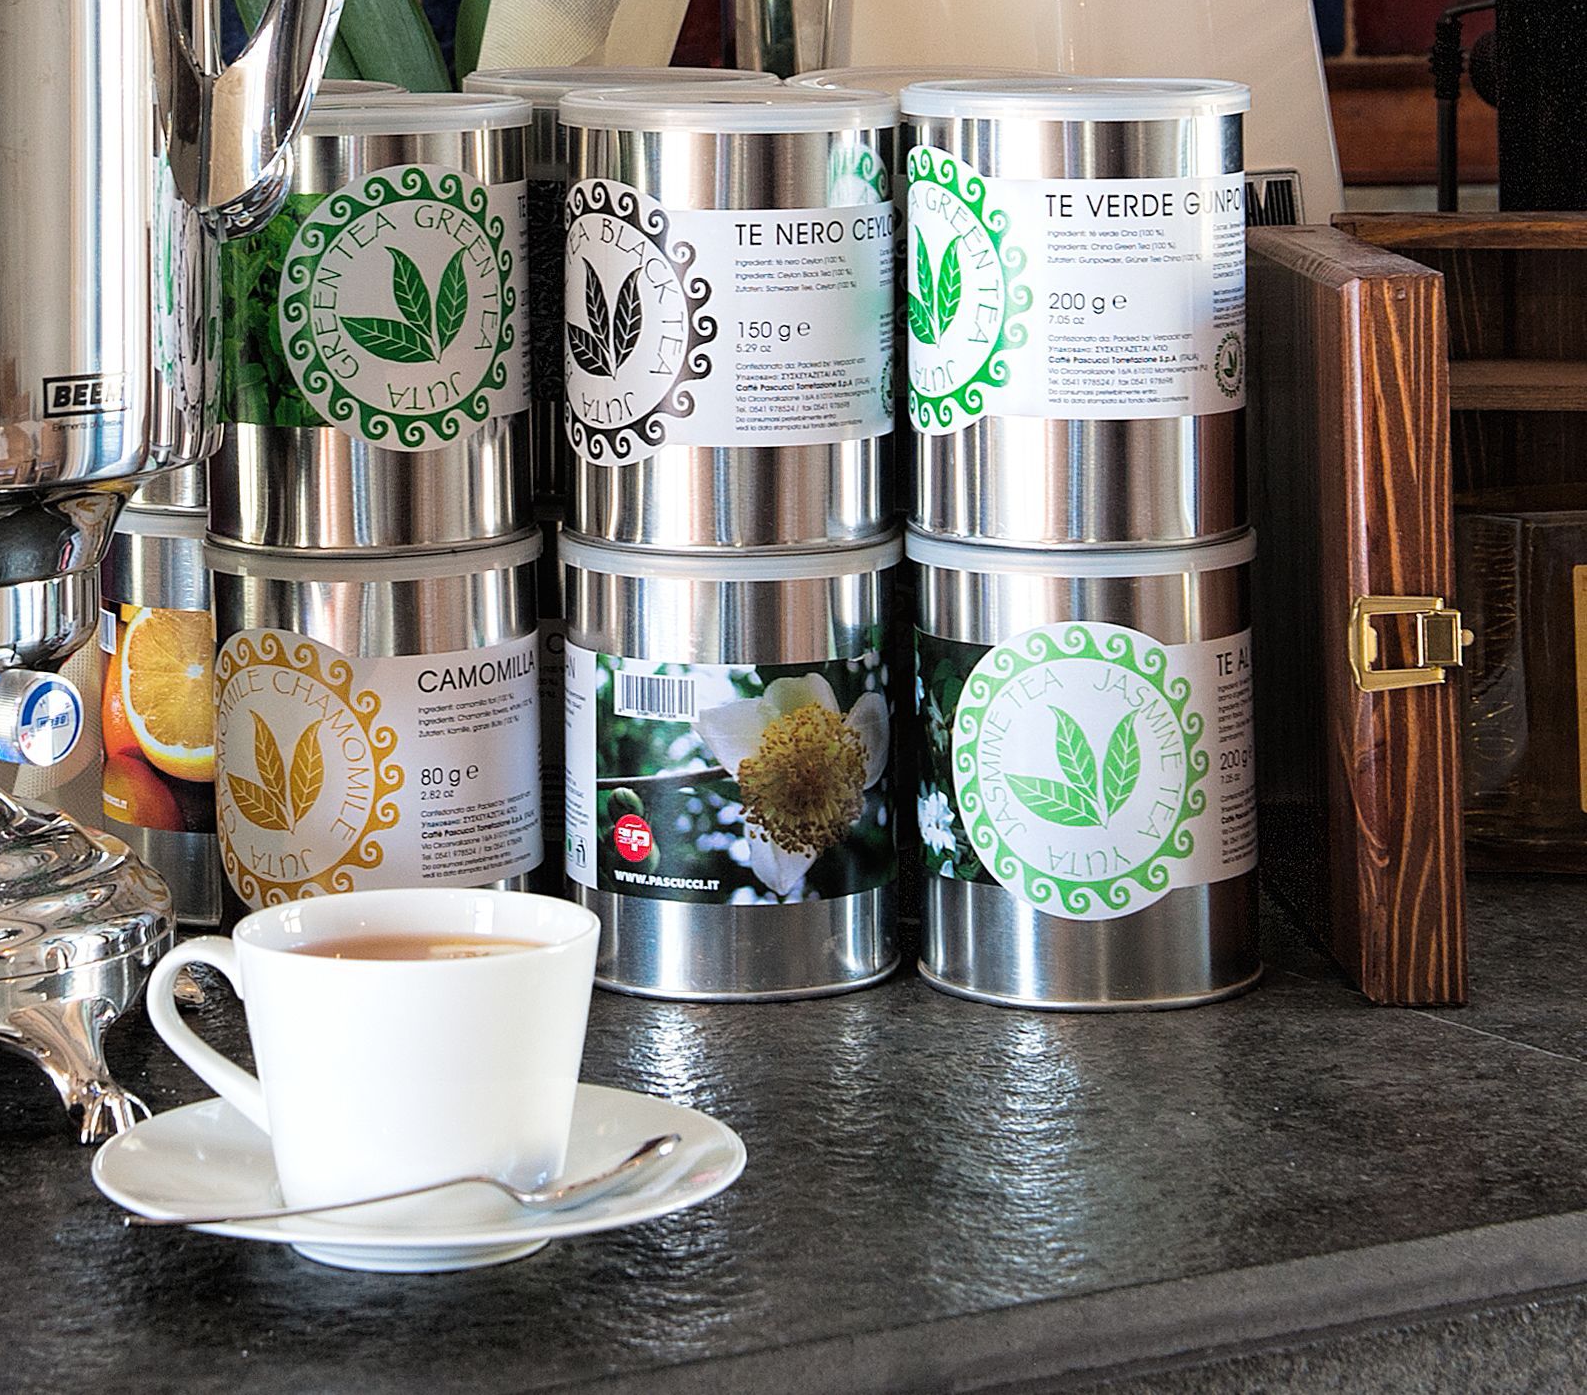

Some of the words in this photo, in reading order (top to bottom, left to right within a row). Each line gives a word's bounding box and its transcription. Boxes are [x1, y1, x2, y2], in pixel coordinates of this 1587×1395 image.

[1045, 193, 1073, 218] TE
[1086, 193, 1173, 218] VERDE
[1183, 187, 1244, 216] GUNPO
[328, 211, 397, 260] TEA
[414, 204, 495, 278] GREEN
[735, 223, 762, 246] TE
[776, 220, 844, 246] NERO
[1091, 242, 1113, 251] China
[1115, 242, 1136, 250] Green
[1138, 242, 1151, 250] Tea
[1150, 255, 1161, 263] Tee
[925, 187, 994, 271] GREEN
[968, 279, 999, 344] TEA
[599, 218, 679, 304] BLACK
[649, 311, 685, 376] TEA
[1048, 292, 1086, 310] 200
[1091, 295, 1105, 314] g
[312, 267, 360, 380] GREEN
[474, 284, 499, 351] TEA
[1048, 315, 1071, 325] 7.05
[1073, 316, 1085, 325] oz
[737, 321, 773, 339] 150
[778, 323, 791, 342] g
[735, 343, 757, 353] 5.29
[759, 344, 772, 353] oz
[1073, 356, 1110, 364] Pascucci
[1112, 354, 1157, 364] Torrefazione
[760, 383, 795, 392] Pascucci
[796, 382, 837, 391] Torrefazione
[417, 649, 535, 693] CAMOMILLA
[1216, 651, 1233, 676] TE
[1001, 668, 1064, 709] TEA
[1092, 668, 1183, 773] JASMINE
[272, 671, 370, 842] CHAMOMILE
[1220, 749, 1241, 771] 200
[421, 767, 444, 786] 80
[449, 768, 461, 787] g
[982, 710, 1028, 838] JASMINE
[420, 789, 441, 801] 2.82
[443, 789, 454, 798] oz
[1137, 782, 1182, 839] TEA
[444, 827, 476, 838] Pascucci
[1047, 846, 1131, 877] YUTA
[614, 869, 720, 891] WWW.PASCUCCI.IT
